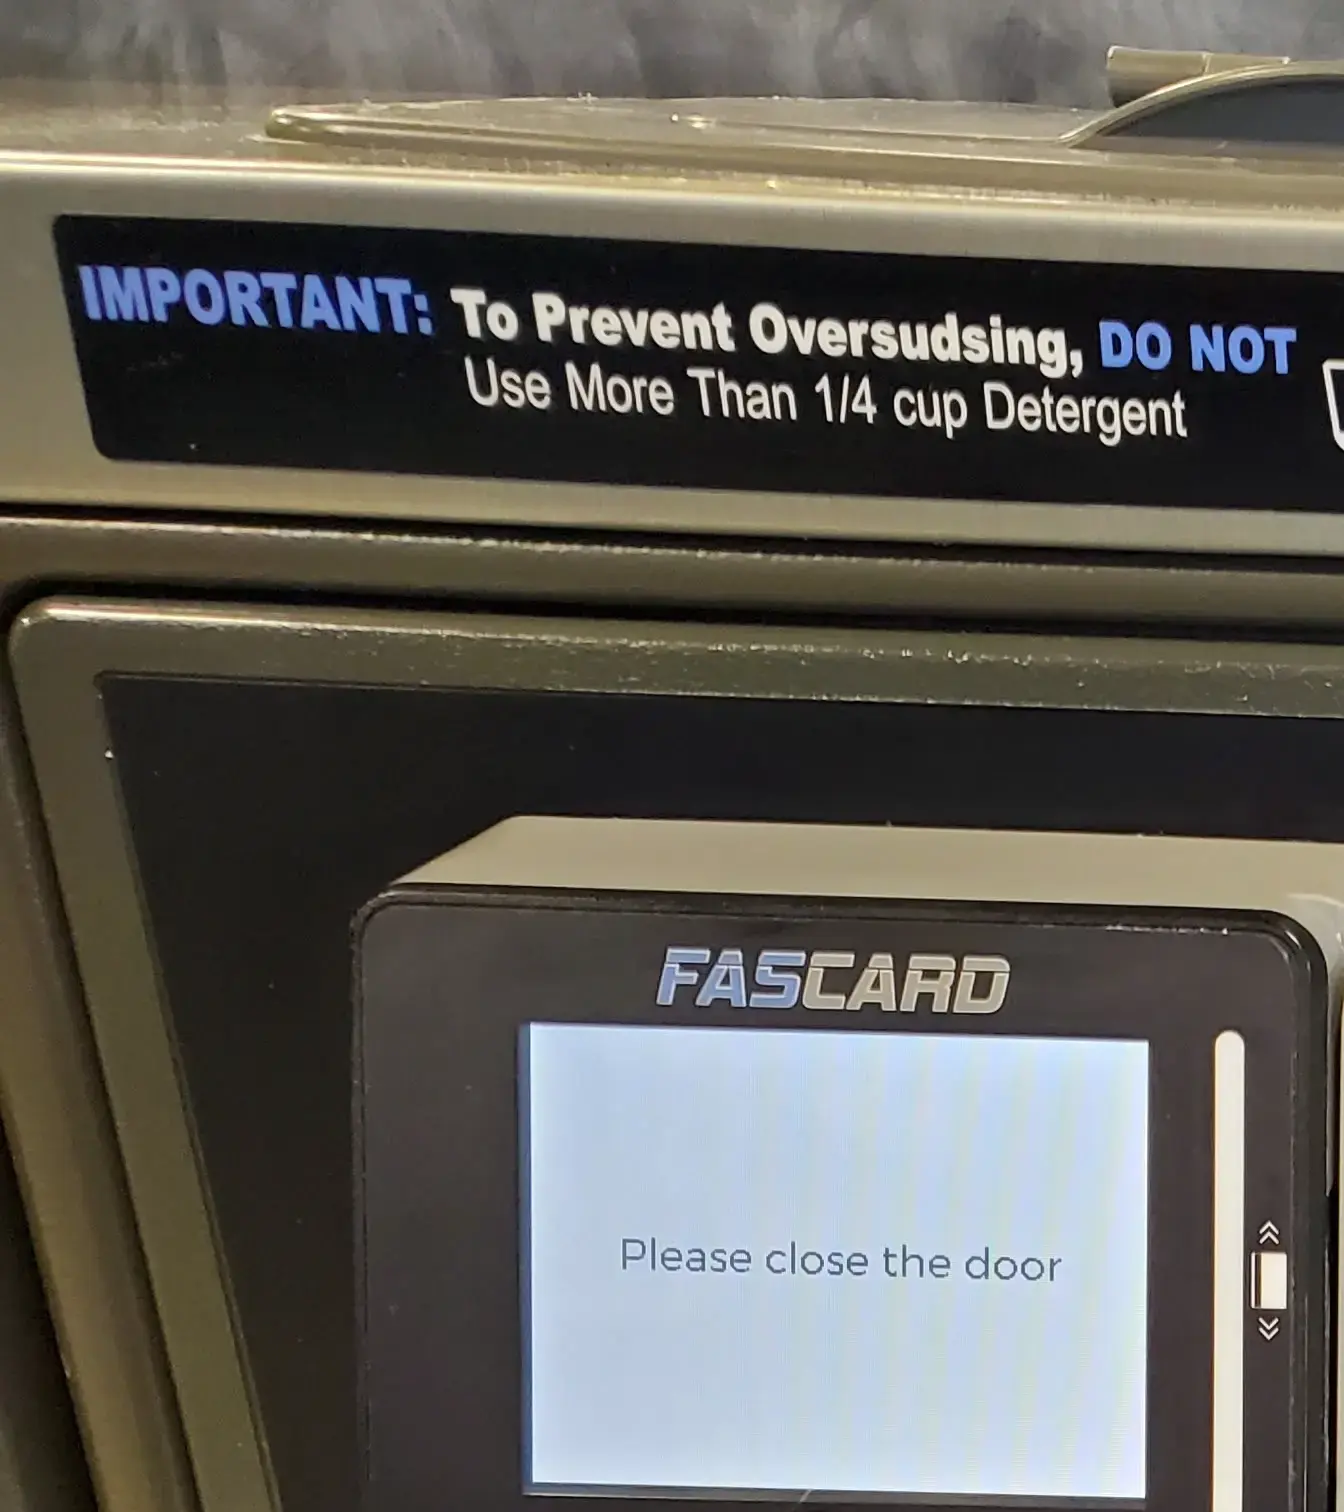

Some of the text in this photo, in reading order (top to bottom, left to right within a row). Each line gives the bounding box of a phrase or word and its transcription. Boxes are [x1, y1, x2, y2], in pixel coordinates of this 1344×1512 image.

[78, 264, 1297, 380] IMPORTANT: To Prevent Oversudsing, DO NOT
[464, 357, 1188, 448] Use More Than 1/4 cup Detergent
[656, 946, 1010, 1014] FASCARD
[620, 1238, 1063, 1284] Please close the door
